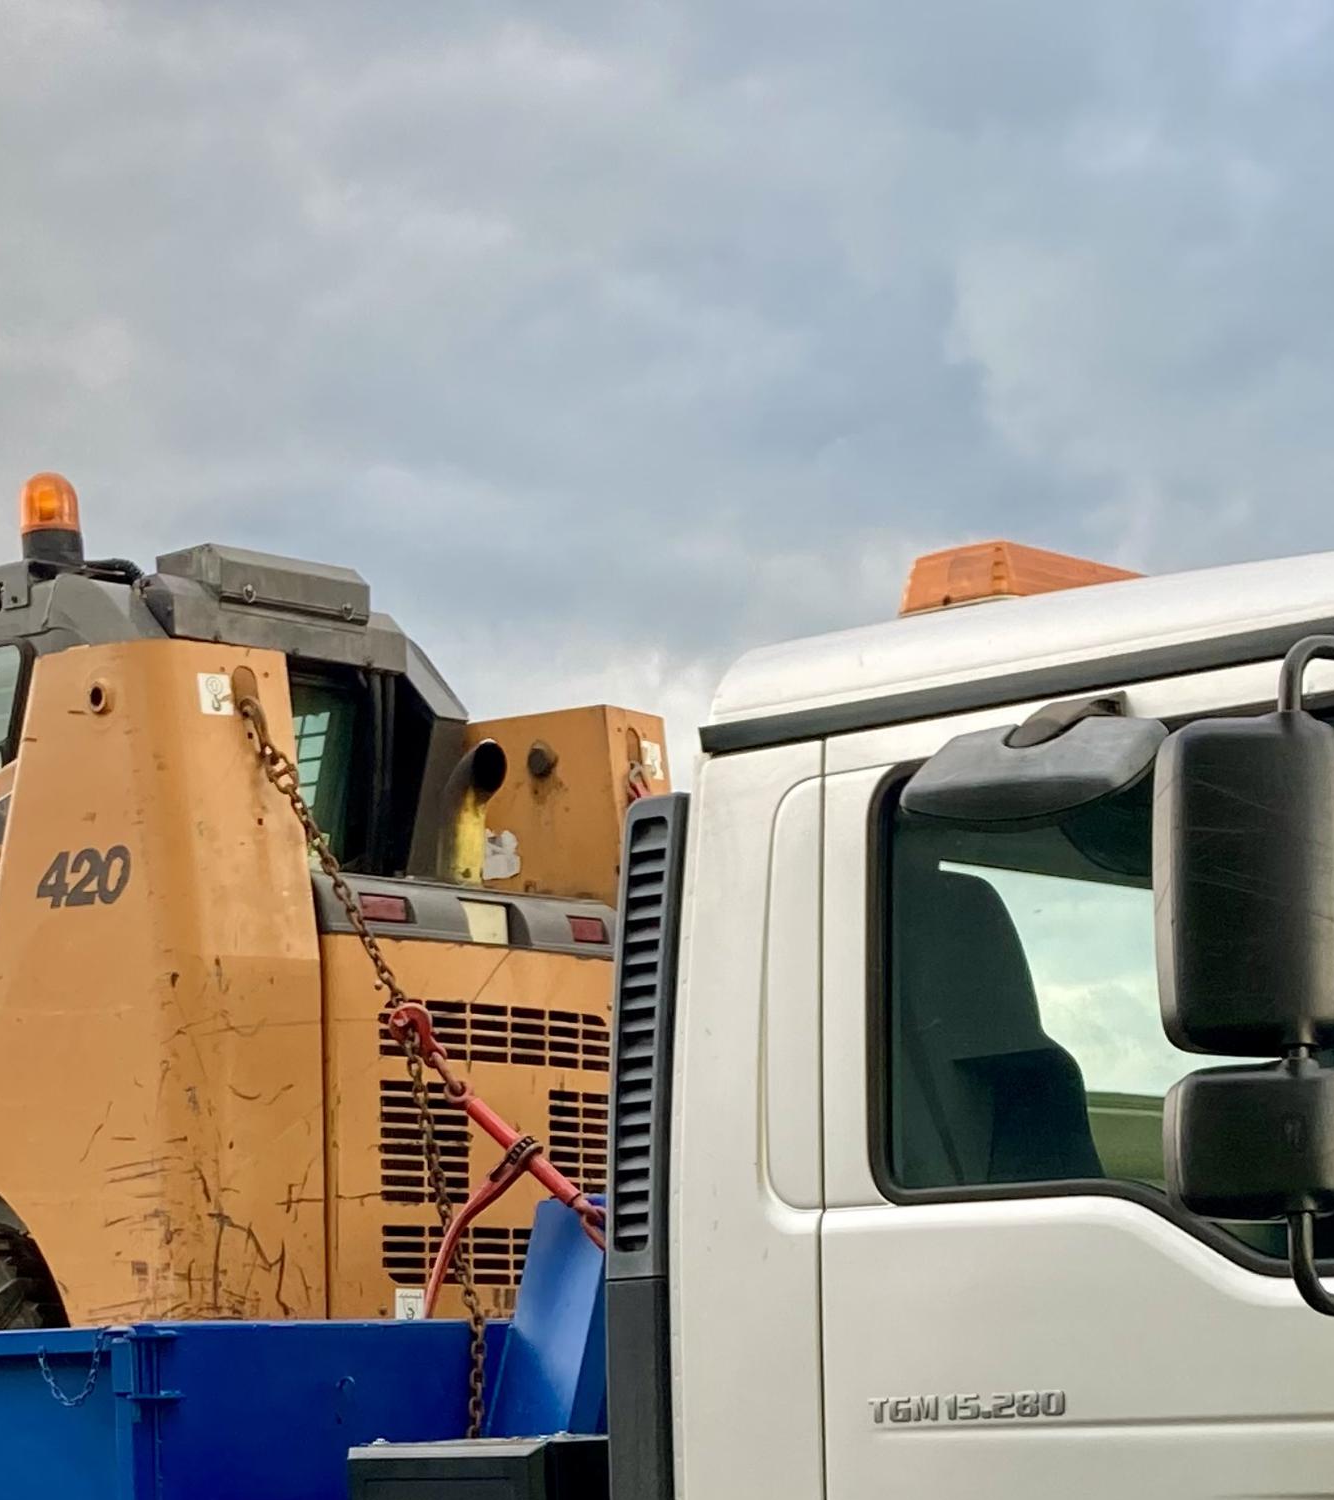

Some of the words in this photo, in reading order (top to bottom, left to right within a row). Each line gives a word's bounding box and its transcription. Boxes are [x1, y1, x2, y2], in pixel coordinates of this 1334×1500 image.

[36, 844, 132, 909] 420
[868, 1394, 939, 1424] TGM
[945, 1389, 1066, 1421] 15.280
